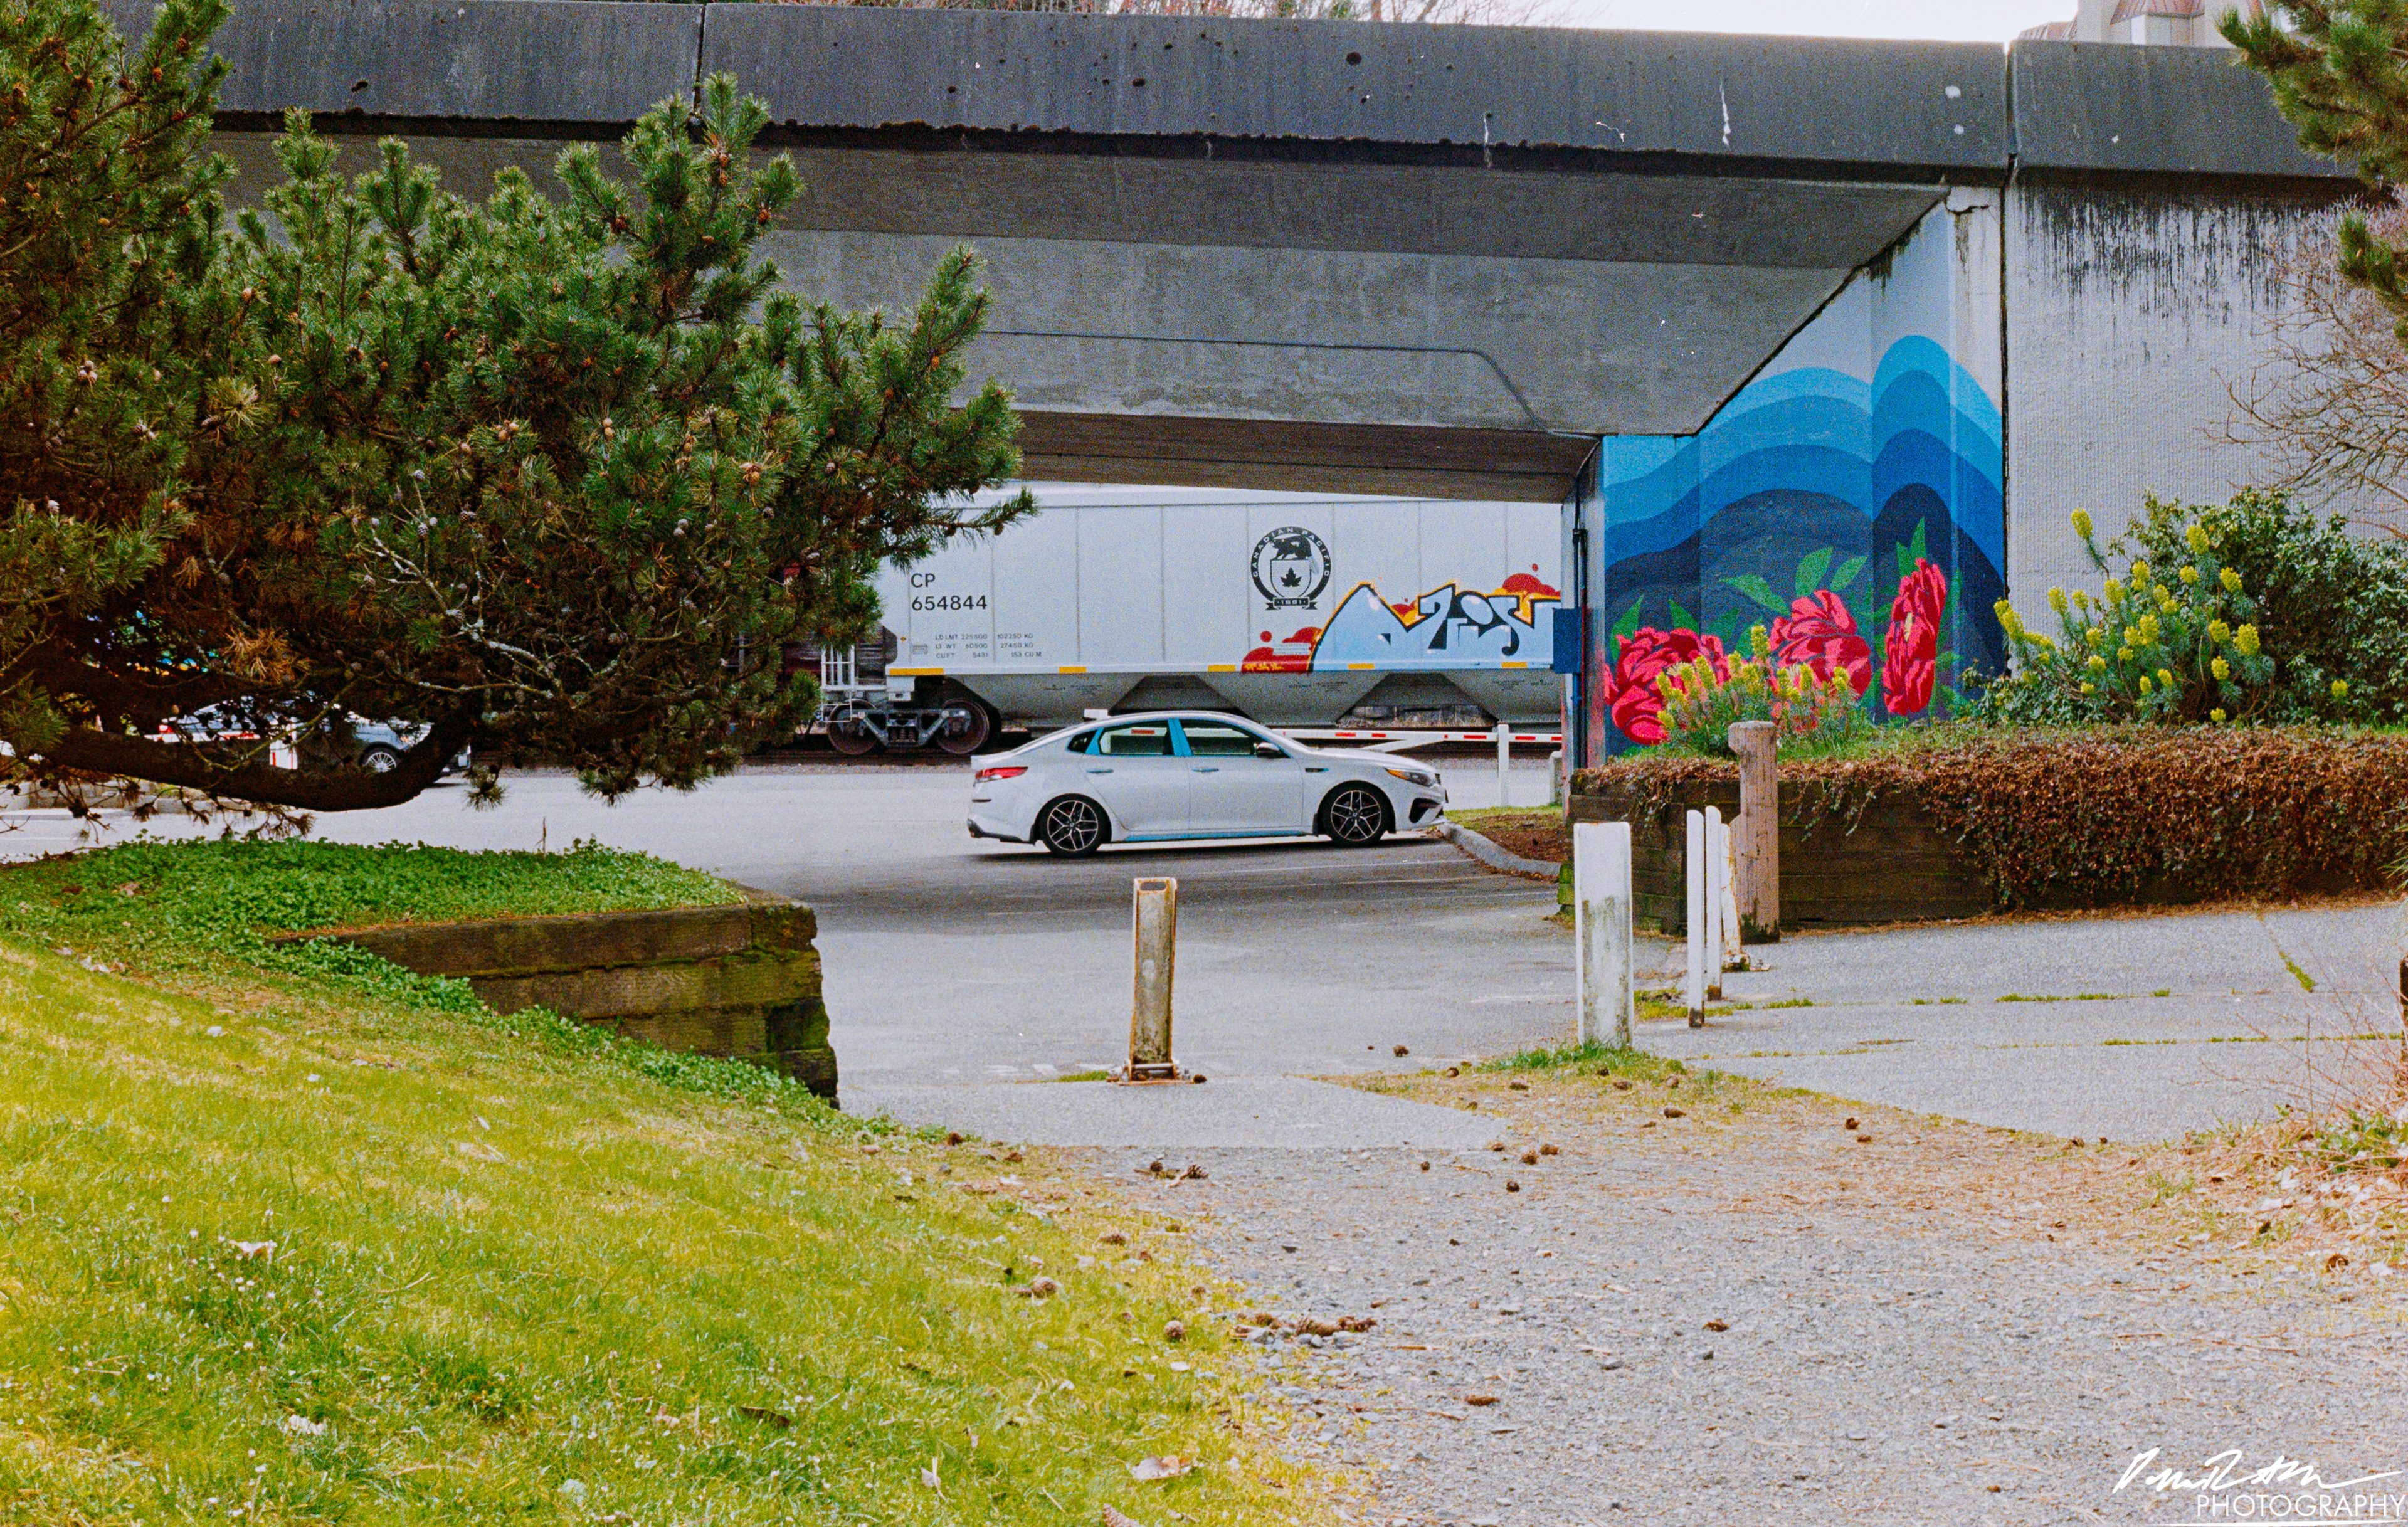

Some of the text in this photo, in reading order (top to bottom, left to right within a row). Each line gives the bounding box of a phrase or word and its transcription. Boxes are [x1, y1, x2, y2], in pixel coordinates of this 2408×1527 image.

[1252, 527, 1329, 577] CANADIAN PACIFIC
[911, 573, 935, 588] CP
[912, 595, 987, 611] 654844
